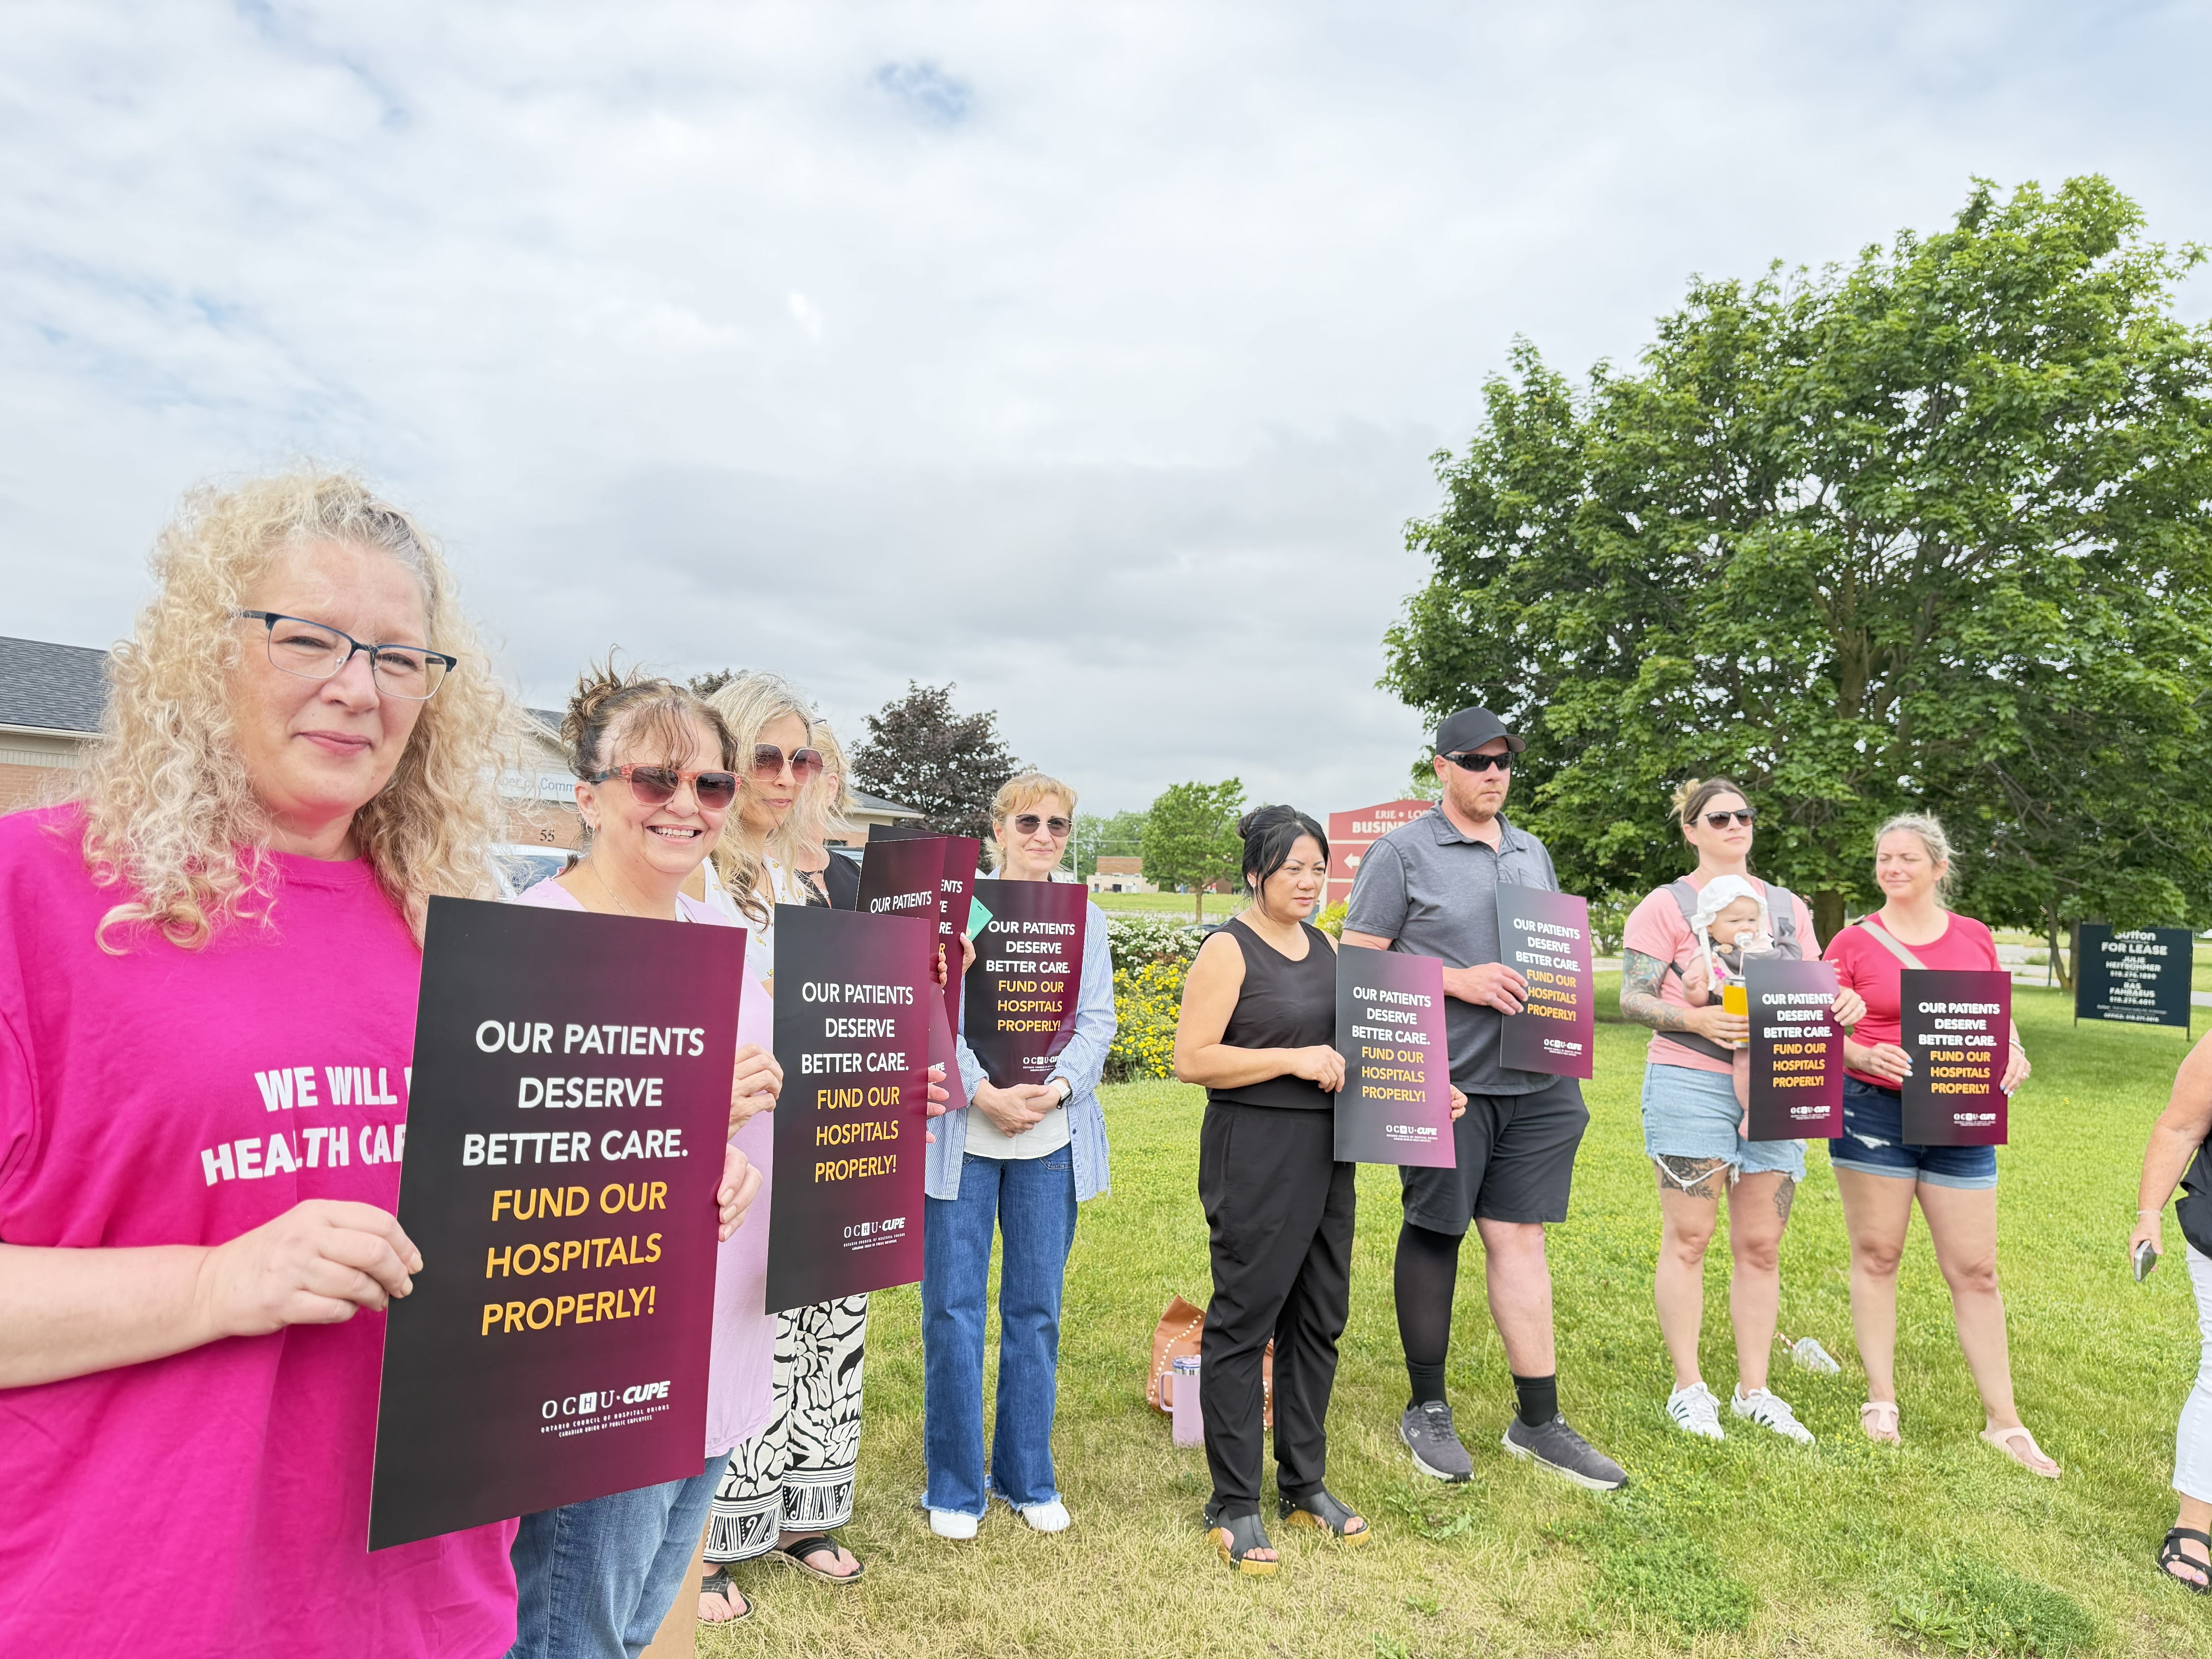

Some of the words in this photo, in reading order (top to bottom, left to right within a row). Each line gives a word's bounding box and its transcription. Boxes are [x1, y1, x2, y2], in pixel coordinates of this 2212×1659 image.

[1376, 810, 1396, 819] ERIE
[539, 830, 555, 842] 55
[871, 897, 890, 913] OUR
[893, 891, 932, 910] PATIENTS
[989, 921, 1018, 933] OUR
[1023, 922, 1075, 935] PATIENTS
[1514, 918, 1535, 931] OUR
[1537, 922, 1580, 939] PATIENTS
[1006, 941, 1061, 954] DESERVE
[1528, 937, 1570, 953] DESERVE
[2101, 942, 2127, 953] FOR
[2129, 943, 2168, 956] LEASE
[986, 960, 1036, 972] BETTER
[1040, 962, 1070, 973] CARE.
[1516, 951, 1552, 967] BETTER
[1553, 957, 1581, 972] CARE.
[999, 981, 1037, 992] FUND
[1041, 981, 1063, 993] OUR
[1527, 969, 1554, 983] FUND
[1556, 975, 1576, 988] OUR
[802, 982, 840, 1002] OUR
[845, 984, 913, 1005] PATIENTS
[1353, 987, 1377, 1001] OUR
[1380, 990, 1431, 1007] PATIENTS
[1528, 986, 1576, 1004] HOSPITALS
[1762, 994, 1786, 1005] OUR
[998, 1000, 1062, 1012] HOSPITALS
[1527, 1004, 1576, 1021] PROPERLY!
[1918, 1002, 1946, 1013] OUR
[1949, 1003, 2000, 1014] PATIENTS
[1367, 1008, 1417, 1025] DESERVE
[1777, 1010, 1823, 1021] DESERVE
[1935, 1018, 1986, 1030] DESERVE
[826, 1018, 895, 1037] DESERVE
[998, 1020, 1060, 1031] PROPERLY!
[1764, 1027, 1802, 1038] BETTER
[1803, 1027, 1832, 1037] CARE.
[476, 1020, 553, 1053] OUR
[564, 1024, 704, 1056] PATIENTS
[1352, 1025, 1393, 1041] BETTER
[1395, 1030, 1430, 1045] CARE.
[1919, 1034, 1963, 1045] BETTER
[1965, 1035, 1997, 1046] CARE.
[1362, 1046, 1394, 1060] FUND
[1397, 1050, 1424, 1063] OUR
[1774, 1044, 1802, 1054] FUND
[1804, 1043, 1826, 1054] OUR
[1930, 1051, 1964, 1061] FUND
[1966, 1051, 1990, 1062] OUR
[802, 1053, 862, 1073] BETTER
[867, 1053, 908, 1072] CARE.
[1773, 1059, 1825, 1071] HOSPITALS
[1362, 1066, 1425, 1082] HOSPITALS
[1931, 1067, 1990, 1078] HOSPITALS
[254, 1066, 318, 1112] WE
[325, 1066, 398, 1106] WILL
[1773, 1076, 1824, 1087] PROPERLY!
[1931, 1083, 1989, 1094] PROPERLY!
[519, 1077, 663, 1108] DESERVE
[818, 1089, 863, 1109] FUND
[868, 1087, 900, 1106] OUR
[1363, 1086, 1425, 1102] PROPERLY!
[816, 1120, 898, 1146] HOSPITALS
[463, 1132, 591, 1166] BETTER
[601, 1129, 688, 1160] CARE.
[816, 1154, 896, 1182] PROPERLY!
[492, 1187, 589, 1221] FUND
[600, 1182, 667, 1213] OUR
[882, 1217, 905, 1231] CUPE
[486, 1233, 662, 1278] HOSPITALS
[482, 1286, 655, 1335] PROPERLY!
[623, 1381, 671, 1404] CUPE
[541, 1423, 569, 1433] ONTARIO
[573, 1417, 600, 1427] COUNCIL
[614, 1409, 643, 1419] HOSPITAL
[647, 1405, 669, 1413] UNIONS
[559, 1428, 582, 1438] CANADIAN
[627, 1415, 652, 1424] EMPLOYEES
